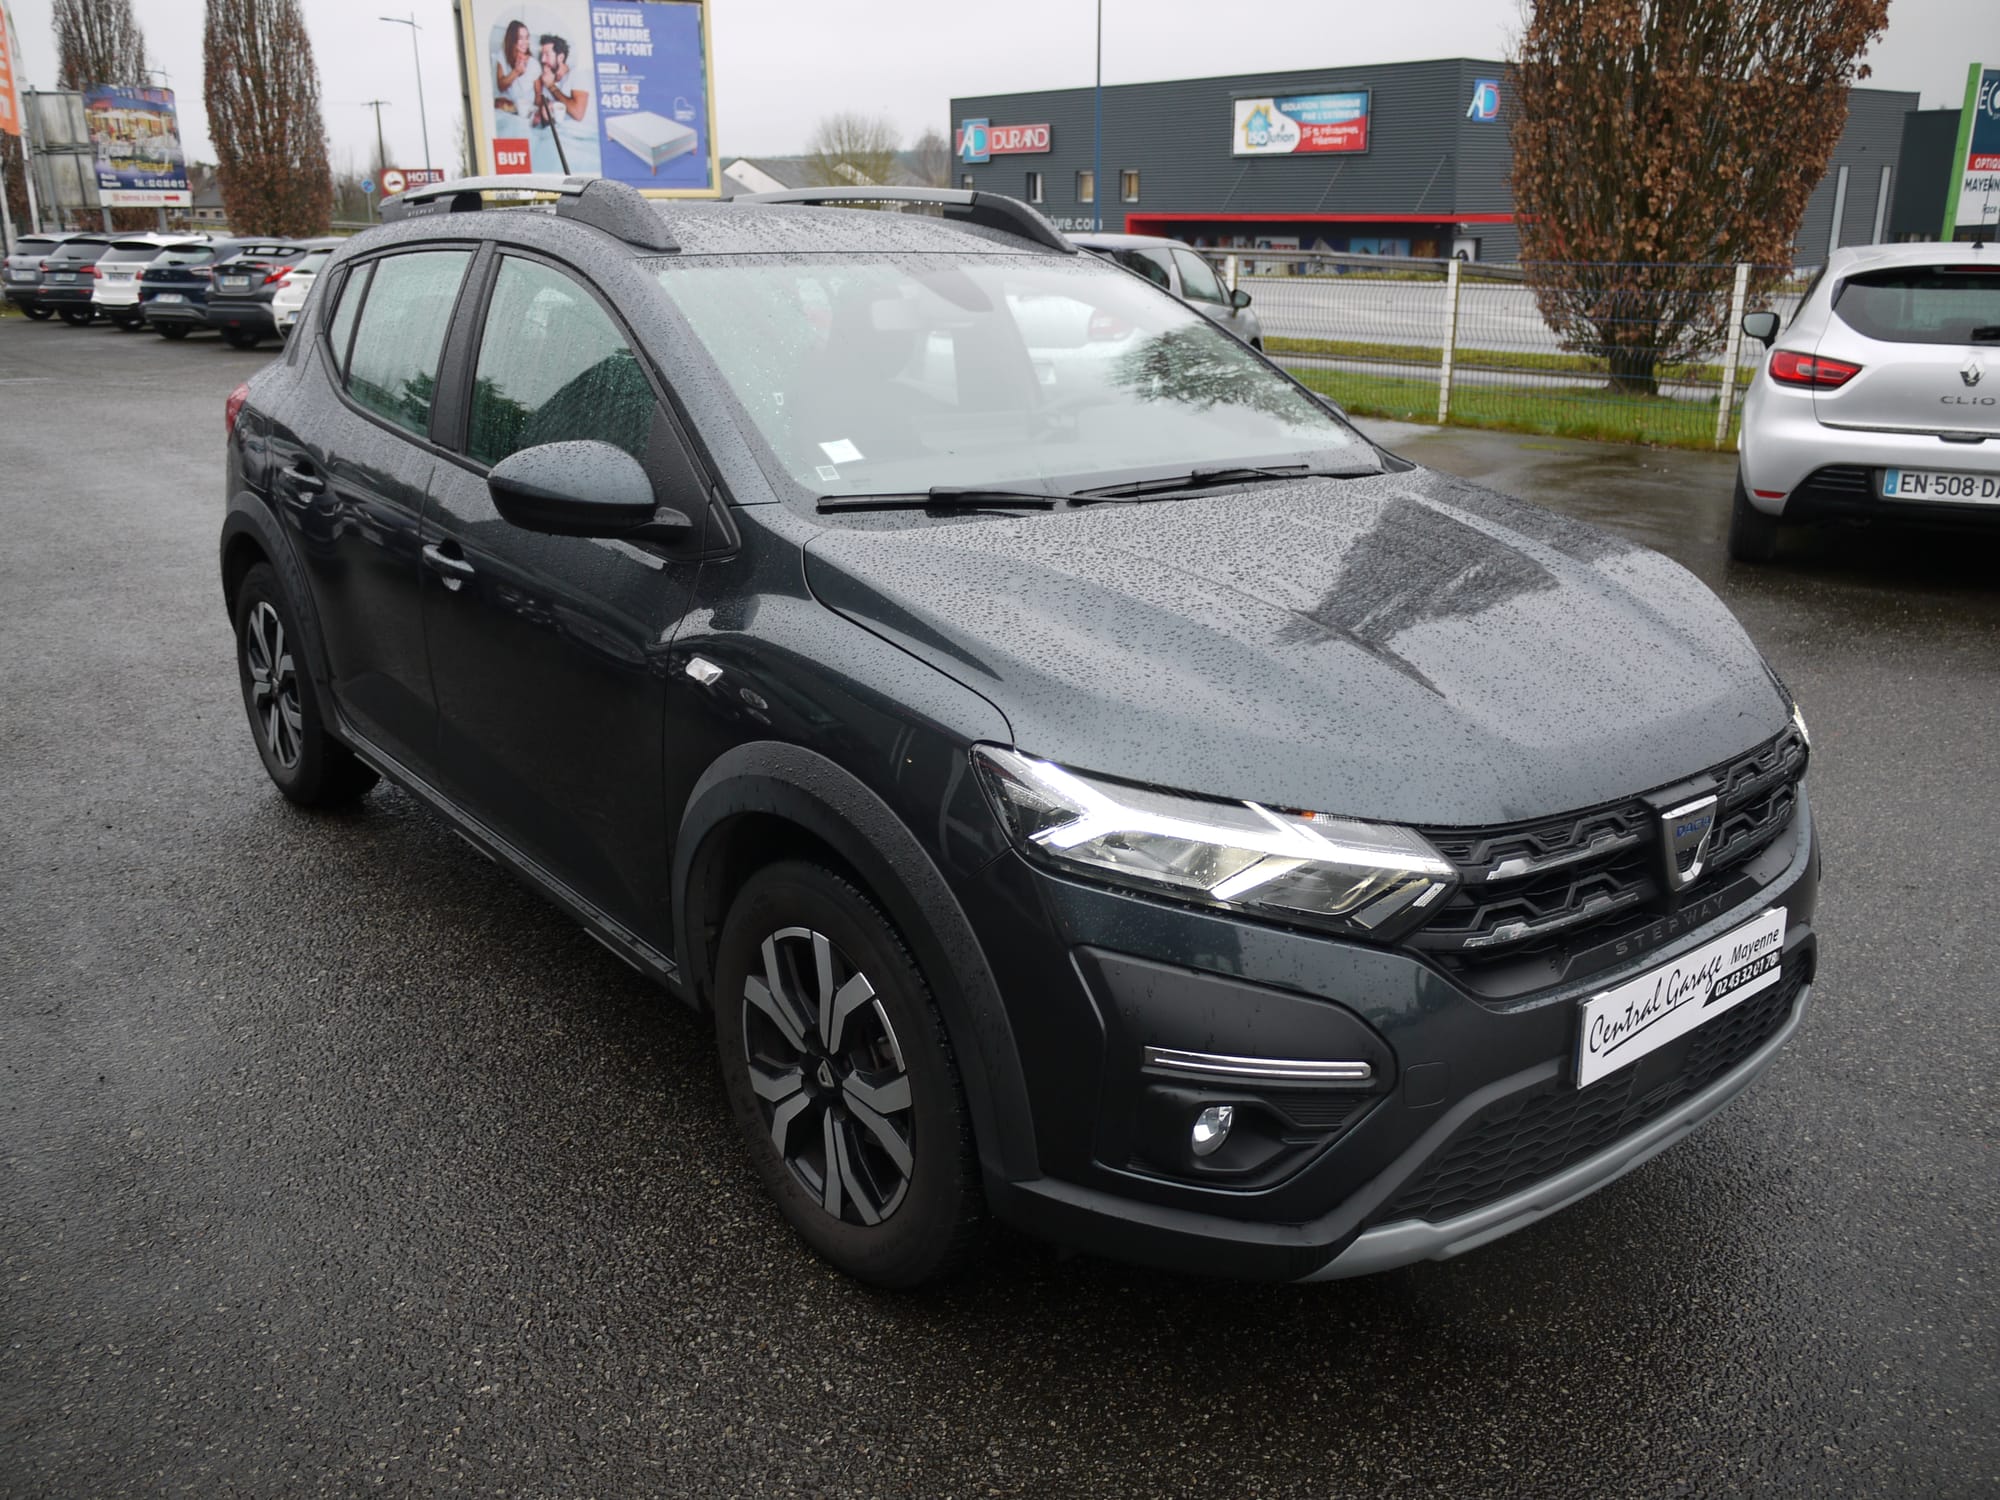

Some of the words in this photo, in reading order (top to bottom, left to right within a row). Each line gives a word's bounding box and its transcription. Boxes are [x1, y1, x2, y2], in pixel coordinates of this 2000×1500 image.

[592, 12, 606, 26] ET
[607, 13, 645, 28] VOTRE
[594, 26, 652, 42] CHAMBRE
[1466, 83, 1501, 119] AD
[957, 124, 989, 157] AD
[992, 127, 1048, 150] DURAND
[497, 150, 527, 166] BUT
[407, 171, 441, 183] HOTEL
[1940, 395, 1996, 406] CLIO
[1615, 895, 1724, 956] STEPWAY
[1589, 976, 1662, 1054] Central
[1665, 954, 1723, 1010] Garage
[1730, 927, 1780, 966] Mayenne
